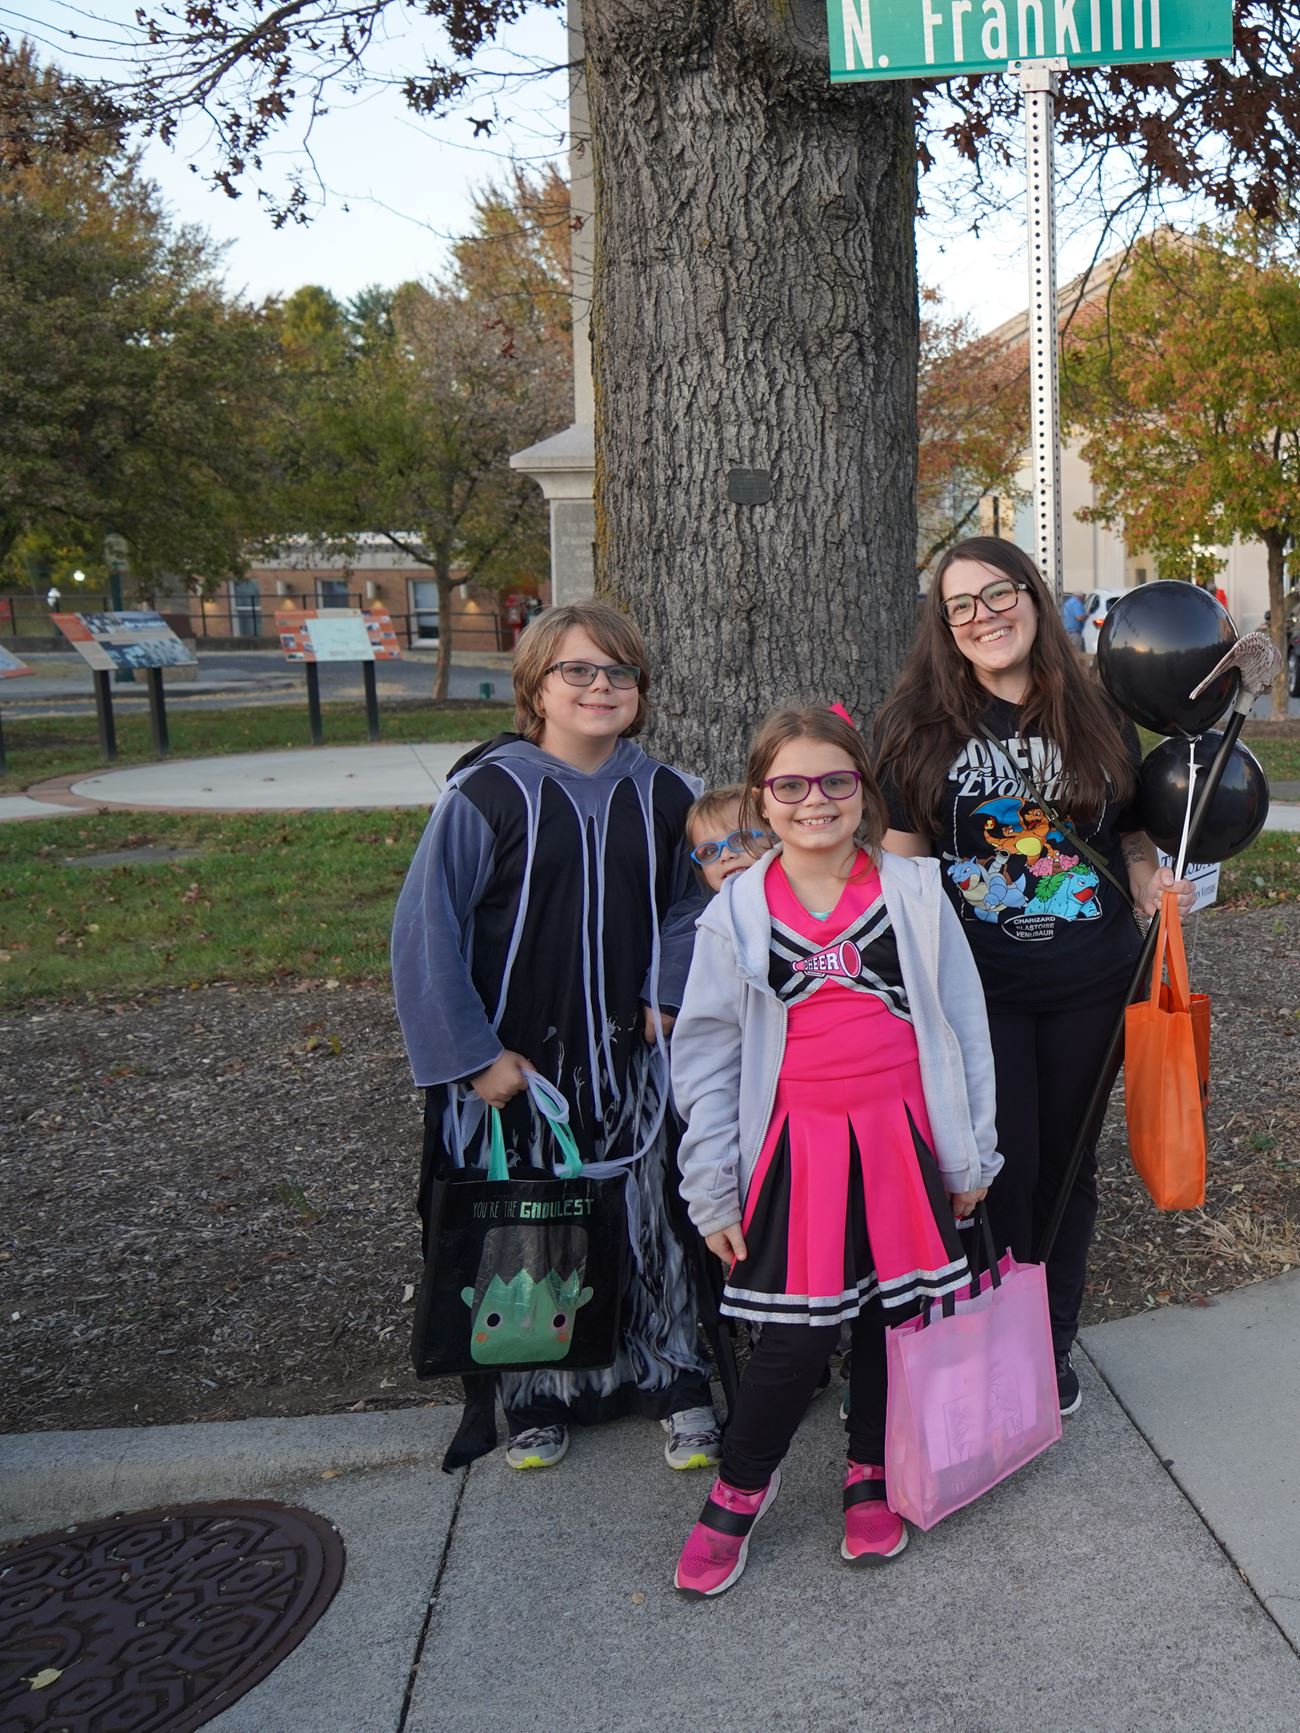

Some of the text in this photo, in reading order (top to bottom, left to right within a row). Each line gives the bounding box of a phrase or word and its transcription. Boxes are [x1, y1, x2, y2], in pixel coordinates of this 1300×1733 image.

[842, 0, 1160, 70] N. Franklin
[1013, 916, 1056, 925] CHARIZARD
[1016, 929, 1054, 938] VENUSAUR
[804, 952, 840, 970] CHEER
[473, 1198, 594, 1219] YOU'RE THE GHOULEST
